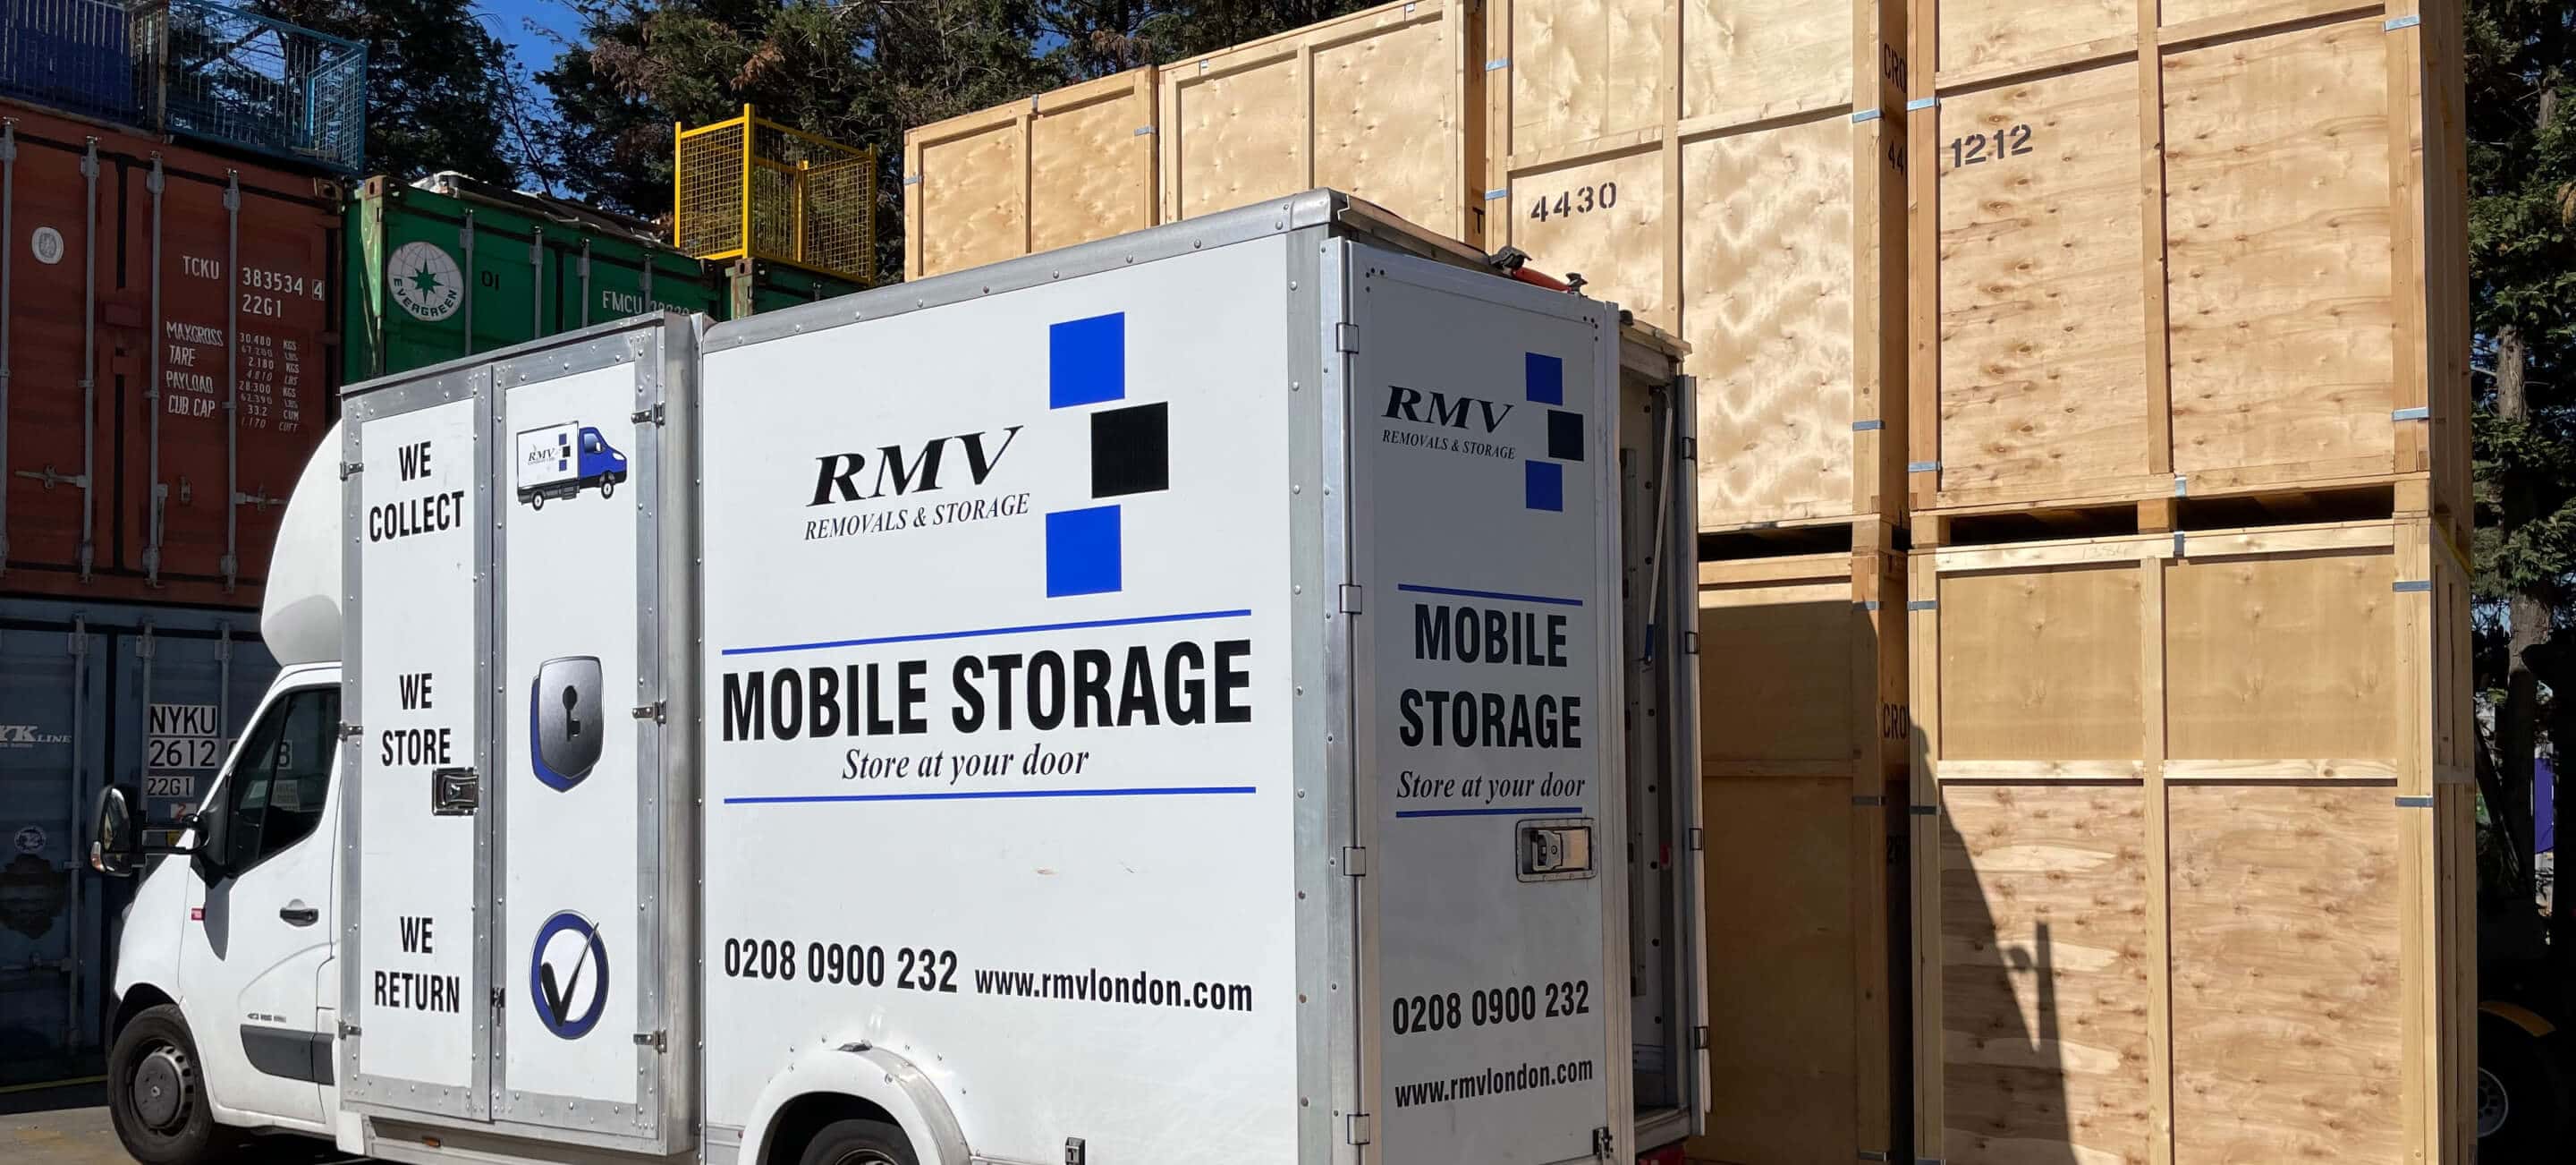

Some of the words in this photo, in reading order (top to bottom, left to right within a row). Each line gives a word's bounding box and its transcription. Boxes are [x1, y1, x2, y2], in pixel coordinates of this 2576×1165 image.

[1951, 123, 2033, 168] 1212
[1530, 182, 1617, 222] 4430
[183, 255, 219, 279] TCKU
[242, 267, 304, 296] 383534
[242, 293, 282, 319] 22G1
[394, 277, 458, 318] EVERGREEN
[602, 290, 642, 315] FMCU
[165, 321, 224, 347] MAXGROSS
[283, 339, 298, 352] KGS
[169, 345, 196, 368] TARE
[285, 362, 301, 374] KGS
[166, 370, 214, 394] PAYLOAD
[282, 386, 297, 398] KGS
[247, 404, 268, 417] 33.2
[1381, 385, 1514, 434] RMV
[399, 441, 431, 480] WE
[529, 448, 555, 462] RMV
[1382, 429, 1448, 452] REMOVALS
[1451, 439, 1460, 453] &
[1462, 440, 1516, 460] STORAGE
[806, 425, 1024, 506] RMV
[369, 491, 464, 542] COLLECT
[804, 509, 908, 540] REMOVALS
[913, 506, 927, 528] &
[933, 493, 1030, 526] STORAGE
[1415, 604, 1568, 668] MOBILE
[399, 673, 433, 710] WE
[723, 659, 928, 742] MOBILE
[952, 639, 1251, 734] STORAGE
[150, 706, 216, 735] NYKU
[1399, 688, 1582, 749] STORAGE
[1884, 703, 1910, 739] CRO
[38, 734, 72, 744] LINE
[150, 740, 216, 767] 2612
[382, 728, 451, 767] STORE
[842, 748, 910, 780] Store
[918, 748, 944, 778] at
[949, 751, 1014, 786] your
[1021, 743, 1090, 775] door
[148, 778, 191, 795] 22G1
[1396, 770, 1455, 798] Store
[1462, 775, 1483, 797] at
[1486, 777, 1535, 804] your
[1540, 771, 1585, 797] door
[400, 916, 433, 954] WE
[724, 938, 796, 980] 0208
[808, 941, 885, 986] 0900
[897, 948, 958, 992] 232
[374, 971, 460, 1013] RETURN
[975, 967, 1253, 1012] www.rmvlondon.com
[1393, 992, 1462, 1034] 0208
[1472, 985, 1536, 1026] 0900
[1546, 980, 1589, 1017] 232
[1394, 1059, 1593, 1108] www.rmvlondon.com
